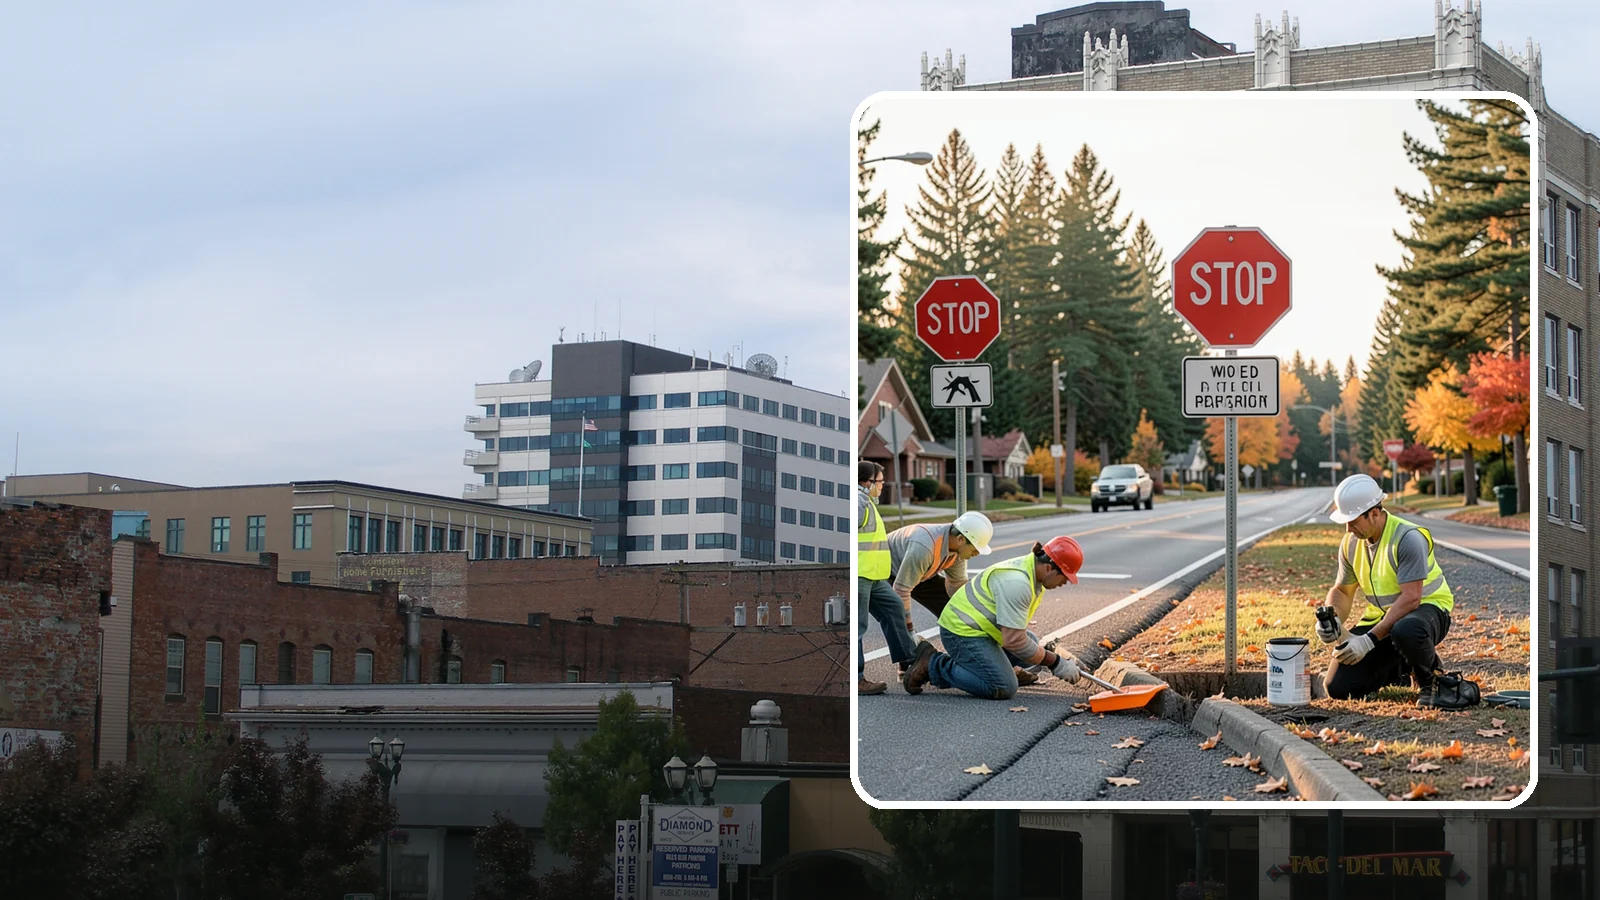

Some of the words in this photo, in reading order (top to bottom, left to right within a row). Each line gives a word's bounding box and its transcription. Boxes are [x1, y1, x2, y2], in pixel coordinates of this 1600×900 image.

[1190, 261, 1277, 305] STOP
[927, 301, 990, 335] STOP
[343, 567, 367, 577] Home
[371, 566, 427, 577] Furnishers
[660, 818, 713, 832] DIAMOND
[1022, 815, 1069, 828] BUILDING
[617, 825, 625, 852] PAY
[628, 825, 637, 852] PAY
[656, 845, 688, 853] RESERVED
[689, 846, 716, 854] PARKING
[616, 856, 625, 893] HERE
[627, 856, 636, 893] HERE
[1346, 856, 1384, 876] DEL
[1392, 857, 1442, 877] MAR
[660, 888, 682, 897] PUBLIC
[683, 889, 710, 898] PARKING
